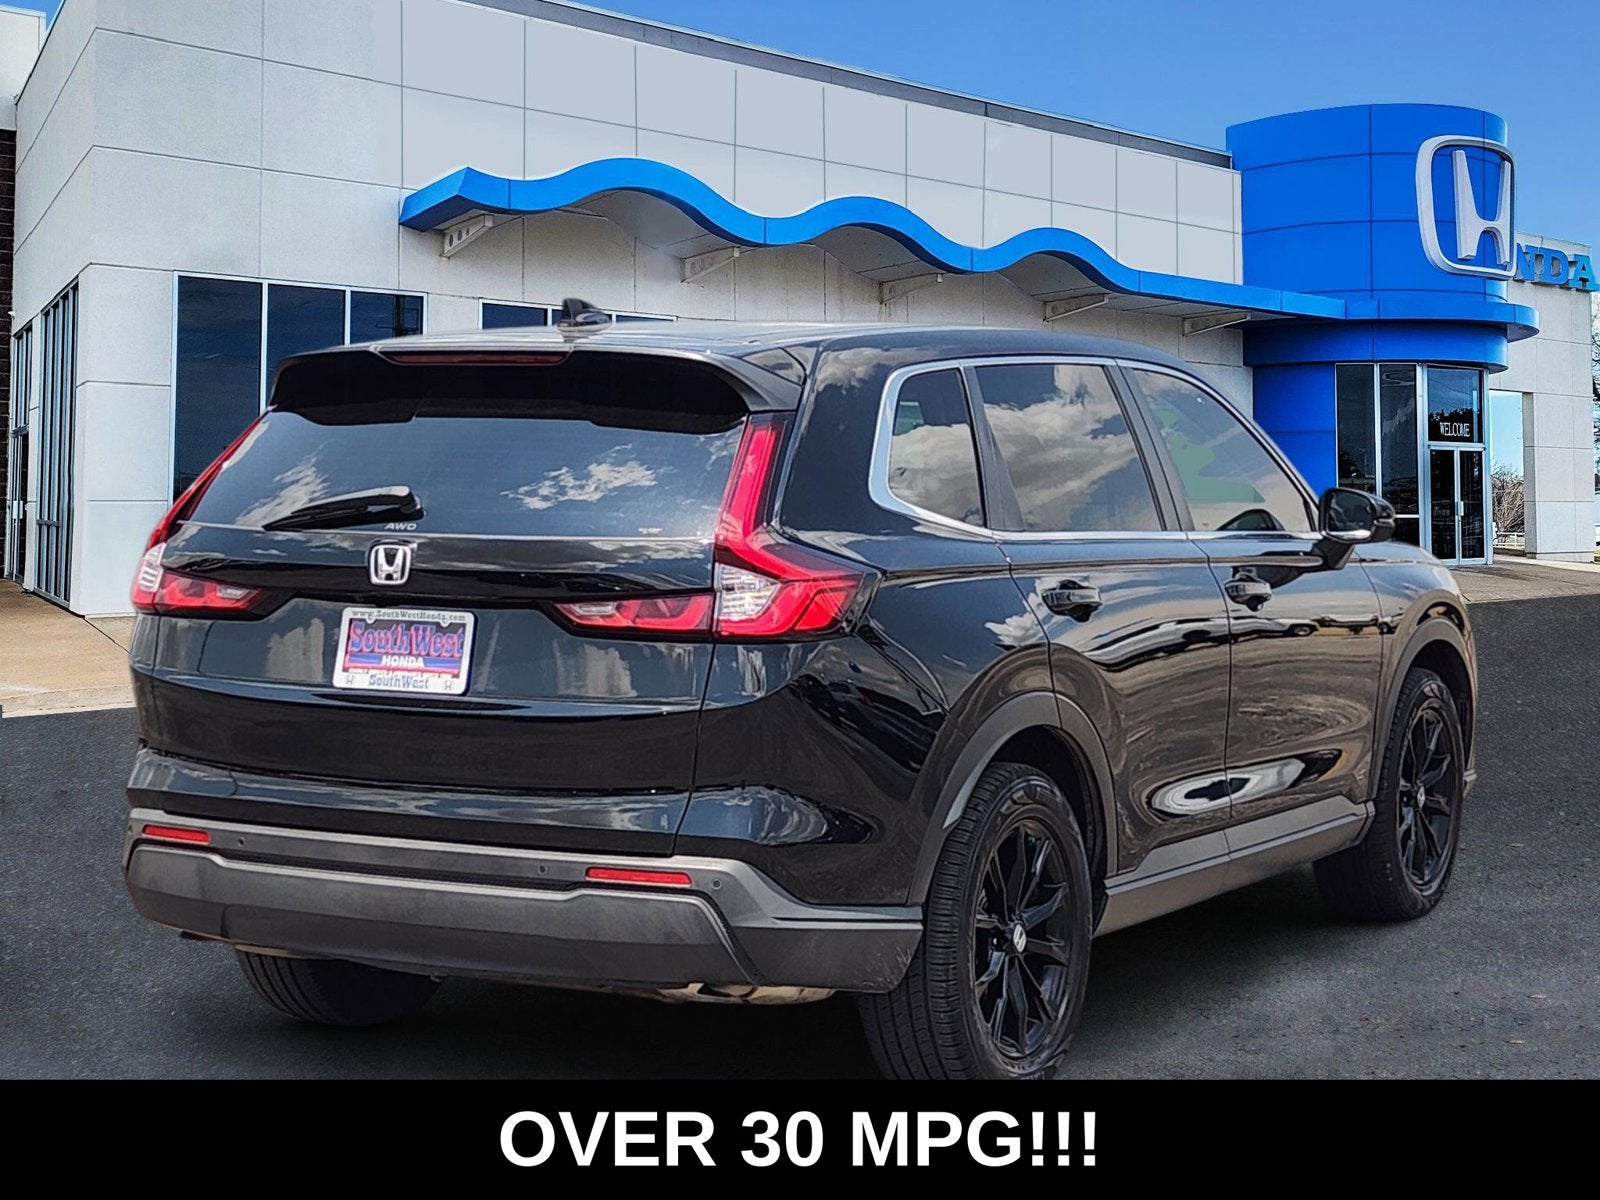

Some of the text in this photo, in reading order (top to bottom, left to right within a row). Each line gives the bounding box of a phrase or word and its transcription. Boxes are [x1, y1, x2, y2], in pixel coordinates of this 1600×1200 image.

[1440, 422, 1470, 437] WELCOME
[384, 523, 417, 531] AWD
[348, 620, 465, 657] SouthWest
[381, 655, 425, 668] HONDA
[368, 673, 430, 689] SouthWest
